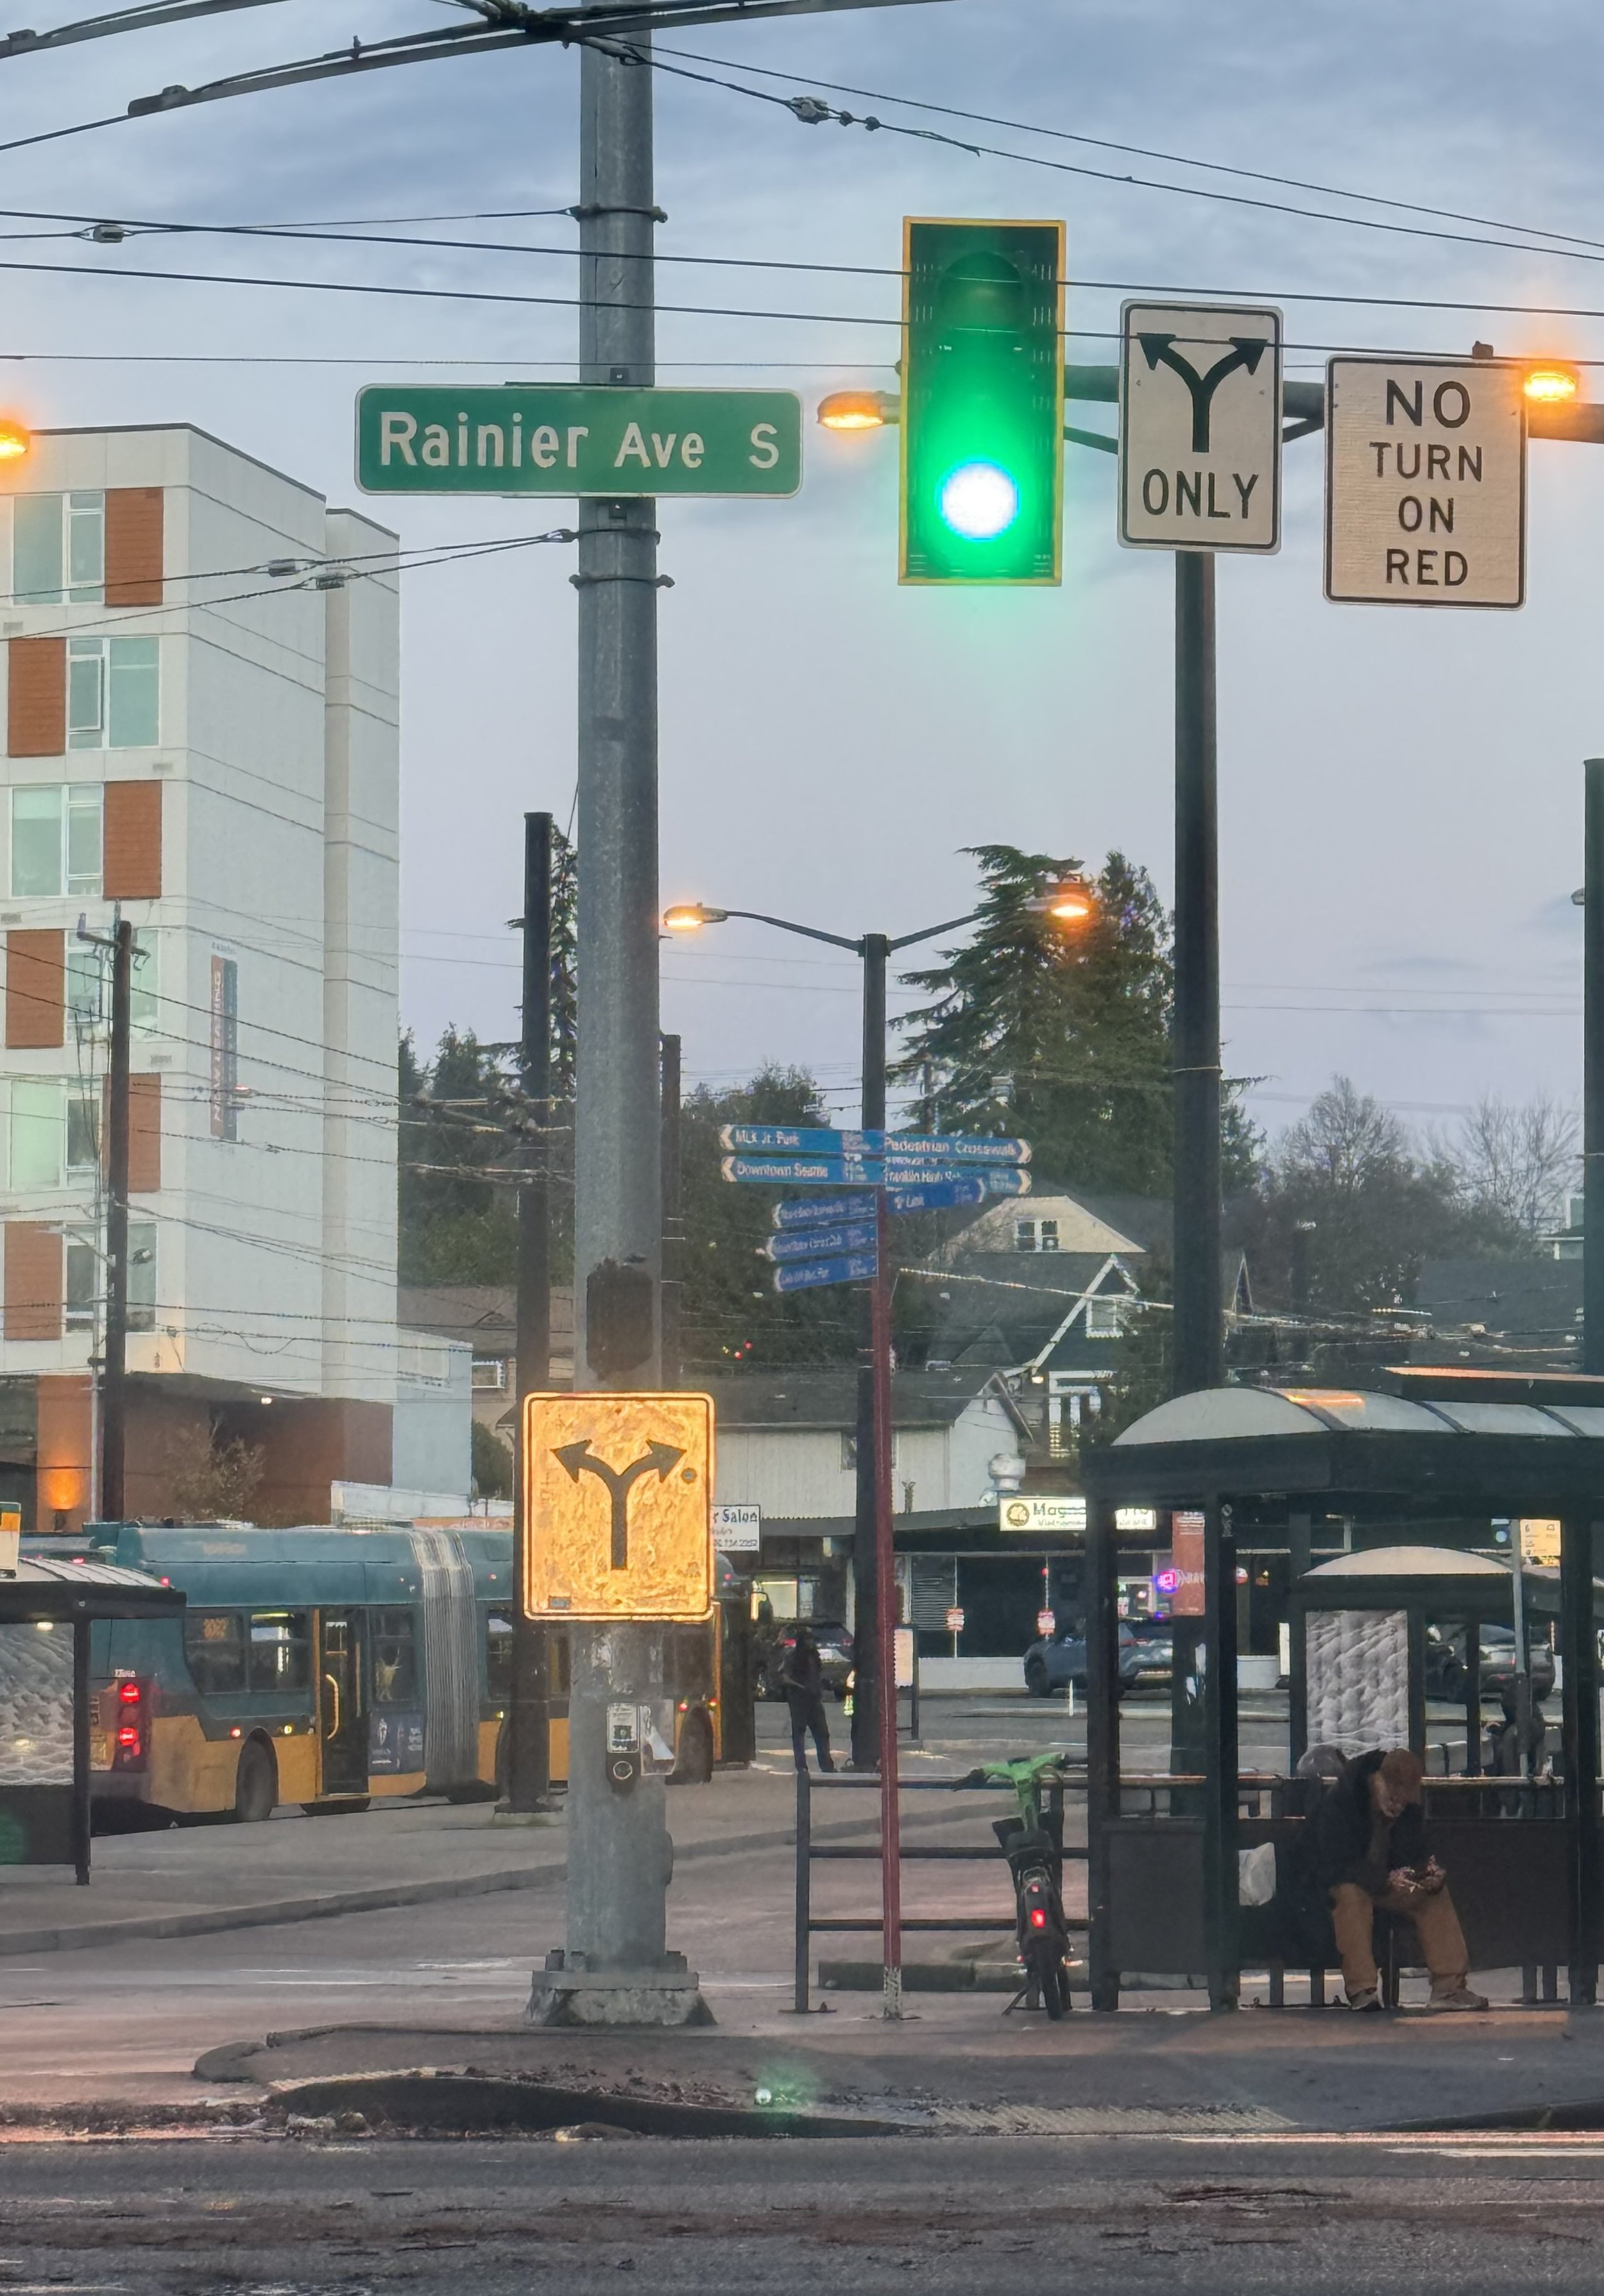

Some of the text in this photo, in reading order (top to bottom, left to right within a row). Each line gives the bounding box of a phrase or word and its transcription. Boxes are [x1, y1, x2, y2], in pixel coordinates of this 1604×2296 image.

[1385, 378, 1471, 429] NO
[380, 411, 780, 470] Rainier Ave S
[1369, 441, 1483, 482] TURN
[1142, 468, 1259, 519] ONLY
[1398, 495, 1455, 534] ON
[1385, 548, 1469, 586] RED
[884, 1137, 950, 1153] Pedestrian
[954, 1139, 1018, 1156] Crosswalk
[737, 1161, 792, 1177] Downtown
[722, 1508, 758, 1523] Salon
